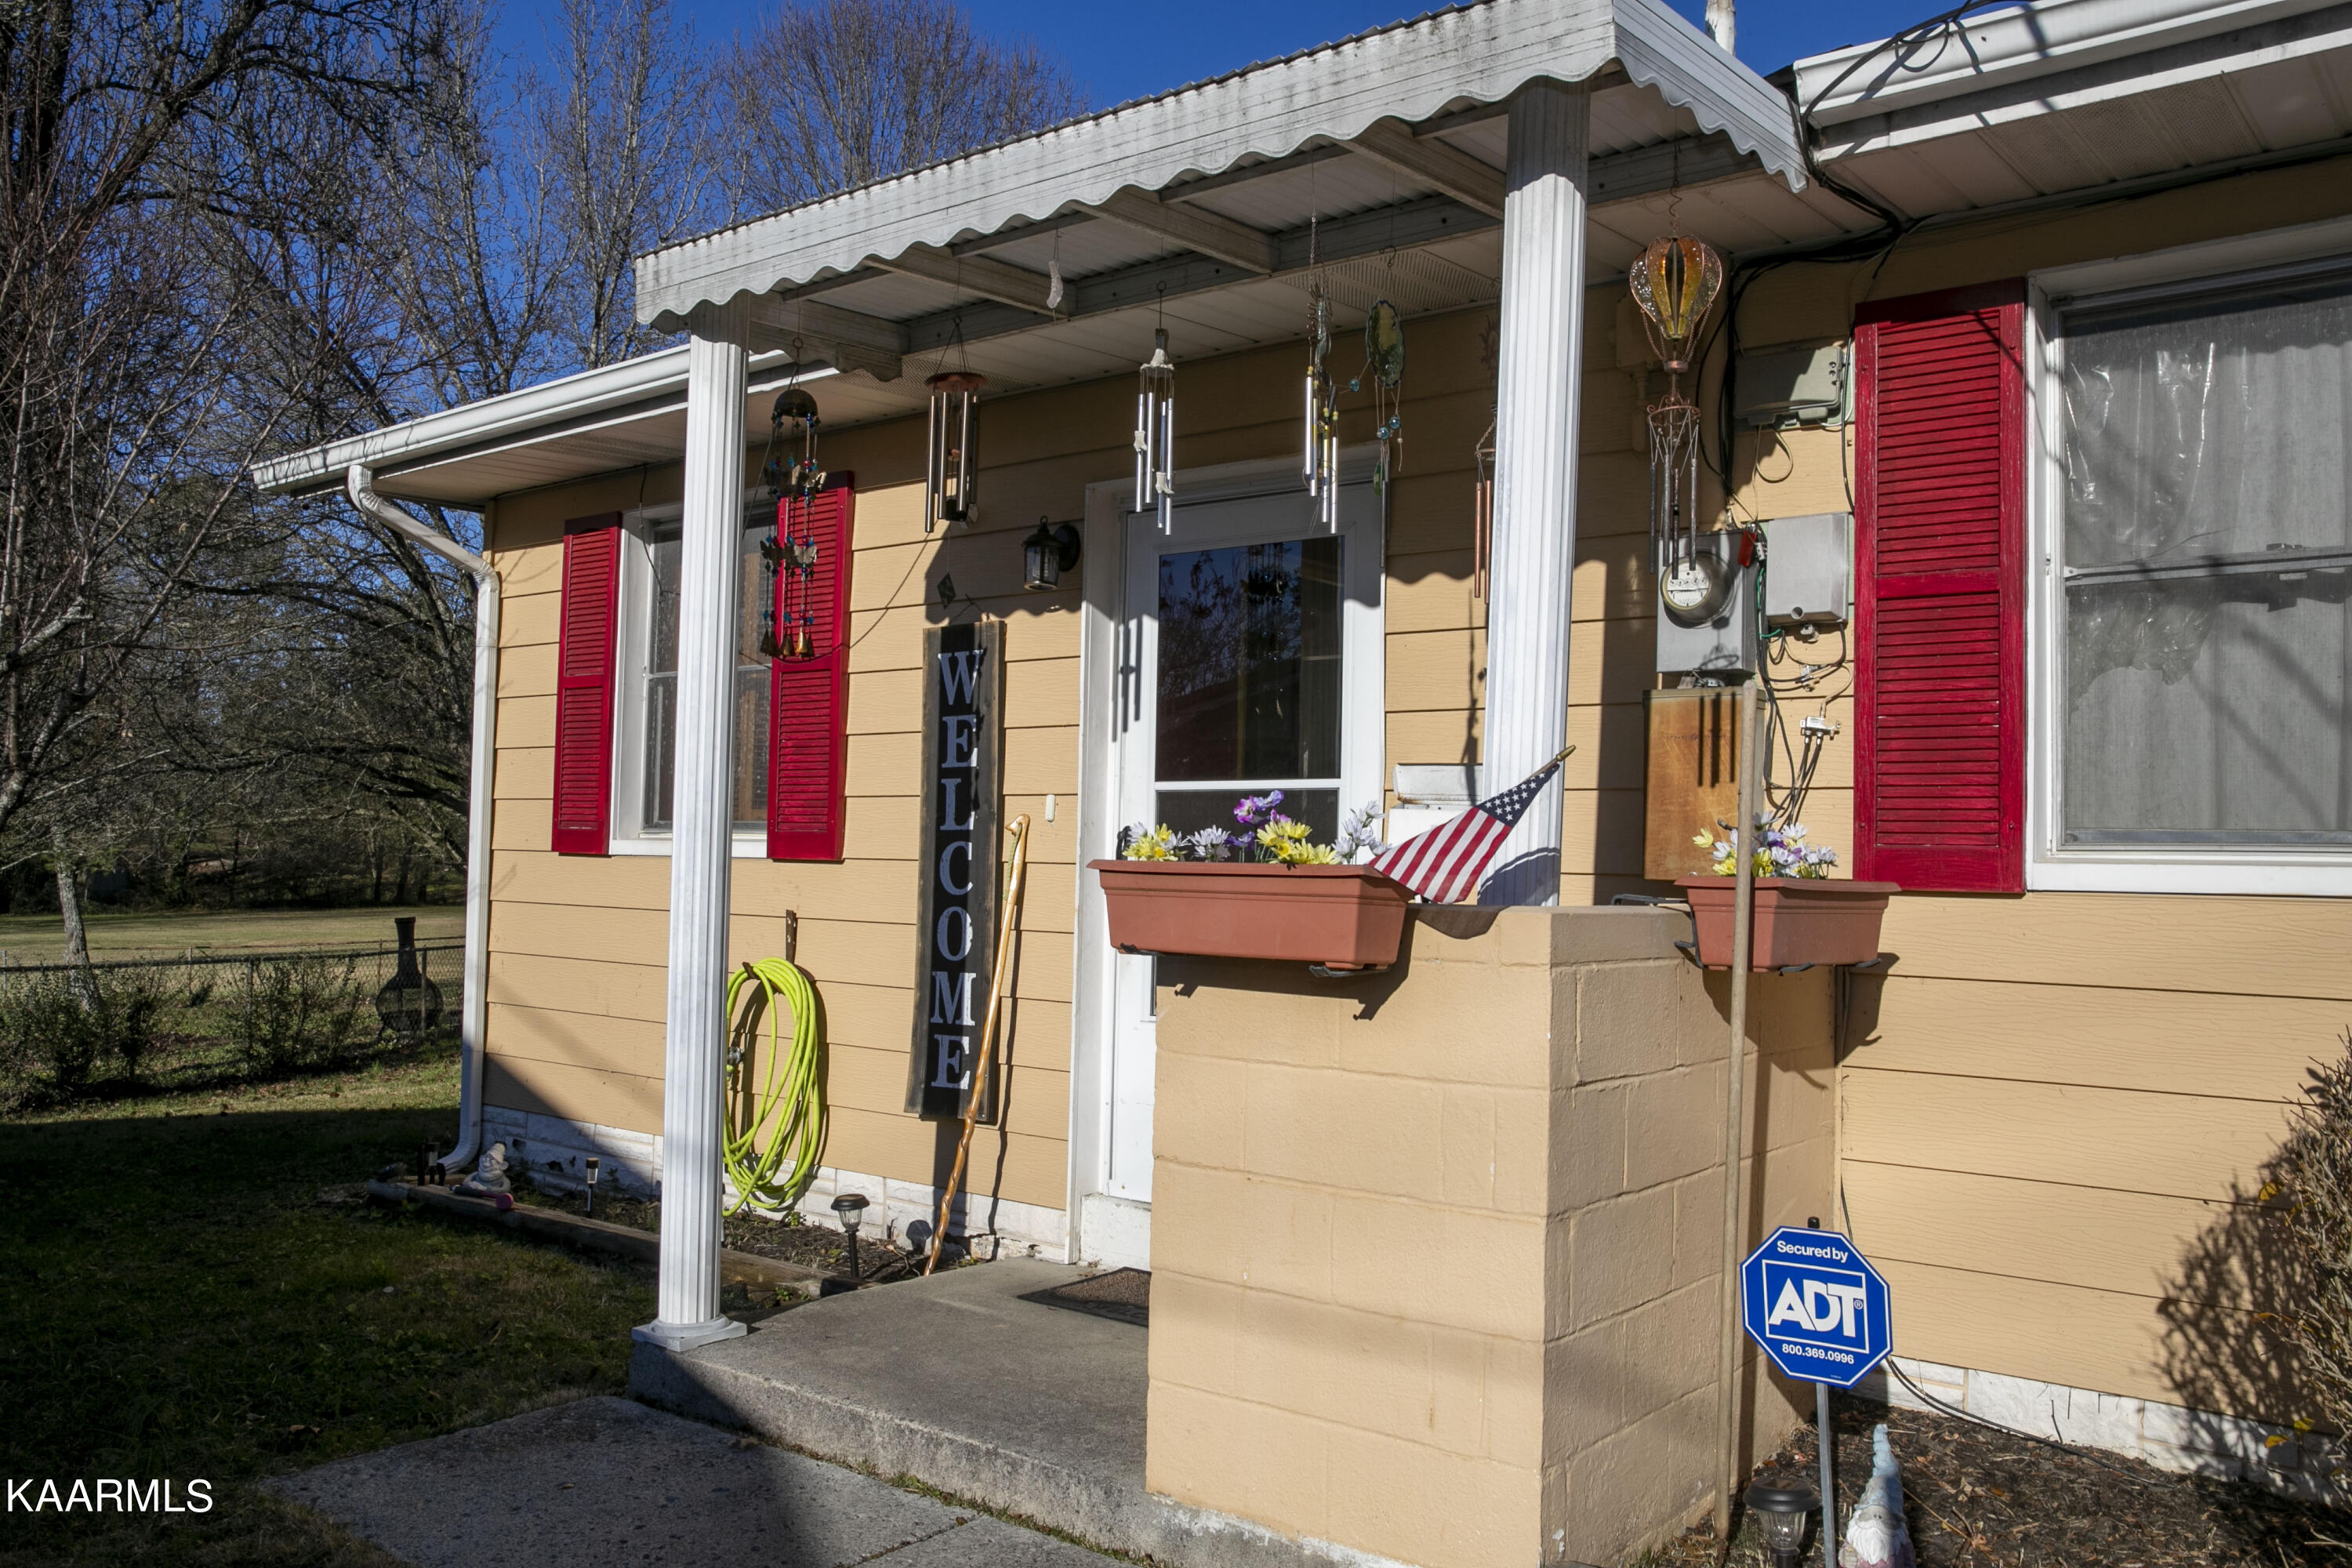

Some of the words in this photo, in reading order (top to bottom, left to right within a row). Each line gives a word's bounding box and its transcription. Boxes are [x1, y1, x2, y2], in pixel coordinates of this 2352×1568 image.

[931, 650, 984, 1090] WELCOME
[1777, 1240, 1831, 1259] Secured
[1831, 1247, 1849, 1264] by
[1782, 1343, 1855, 1364] 800.369.0996
